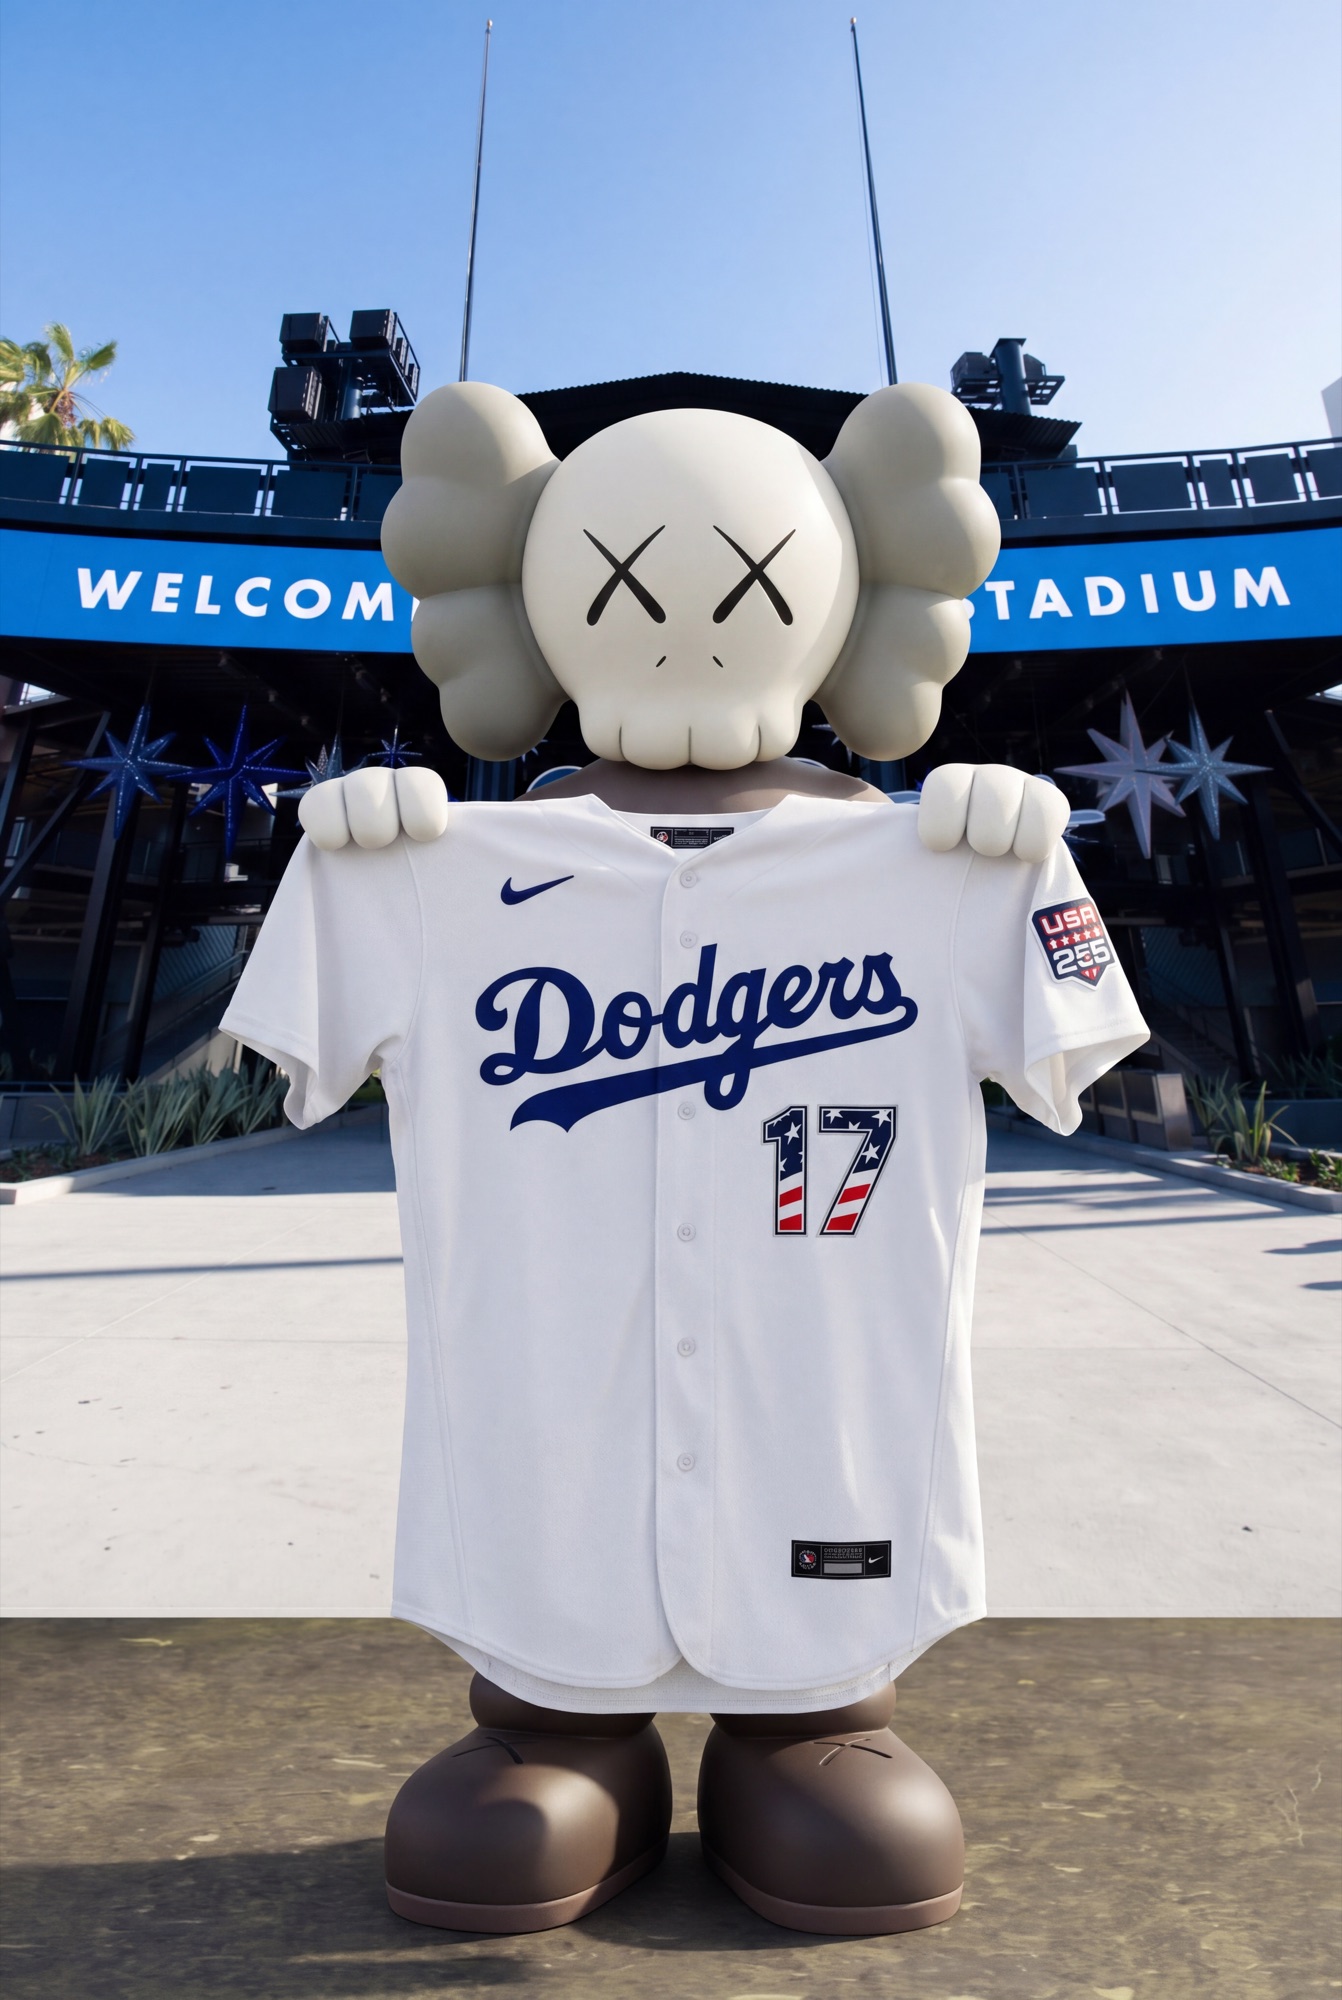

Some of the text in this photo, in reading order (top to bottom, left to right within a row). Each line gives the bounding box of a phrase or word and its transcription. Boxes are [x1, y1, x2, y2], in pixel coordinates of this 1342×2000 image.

[77, 567, 420, 622] WELCOM
[1040, 905, 1098, 935] USA
[475, 943, 914, 1112] Dodgers
[761, 1104, 898, 1238] 17
